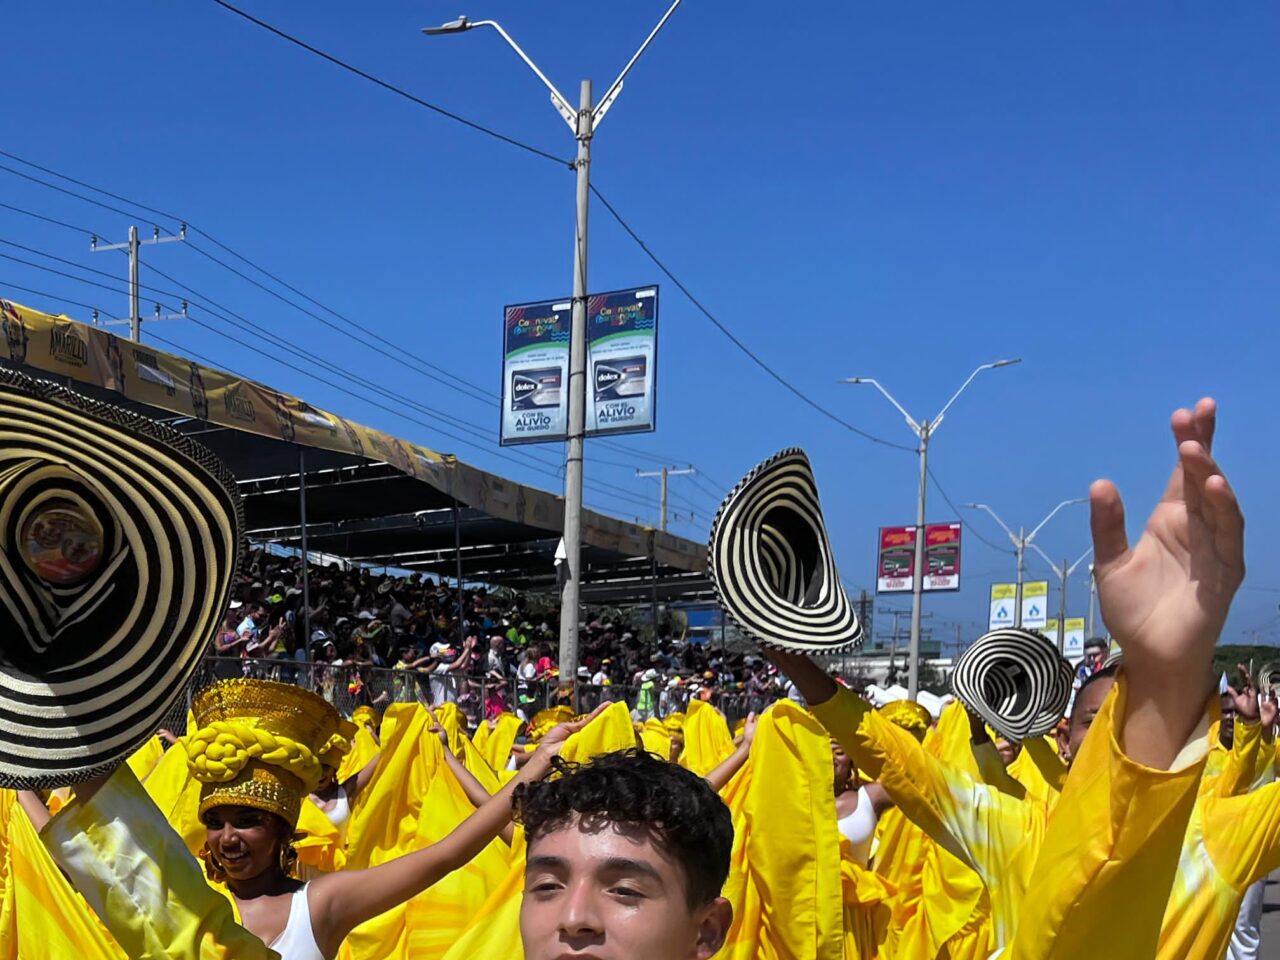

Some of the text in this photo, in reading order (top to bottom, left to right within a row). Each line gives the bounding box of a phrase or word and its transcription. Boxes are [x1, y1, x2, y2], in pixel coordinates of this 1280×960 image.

[598, 372, 619, 382] dolex
[515, 382, 535, 392] dolex
[598, 406, 636, 418] ALIVIO
[515, 416, 551, 427] ALIVIO
